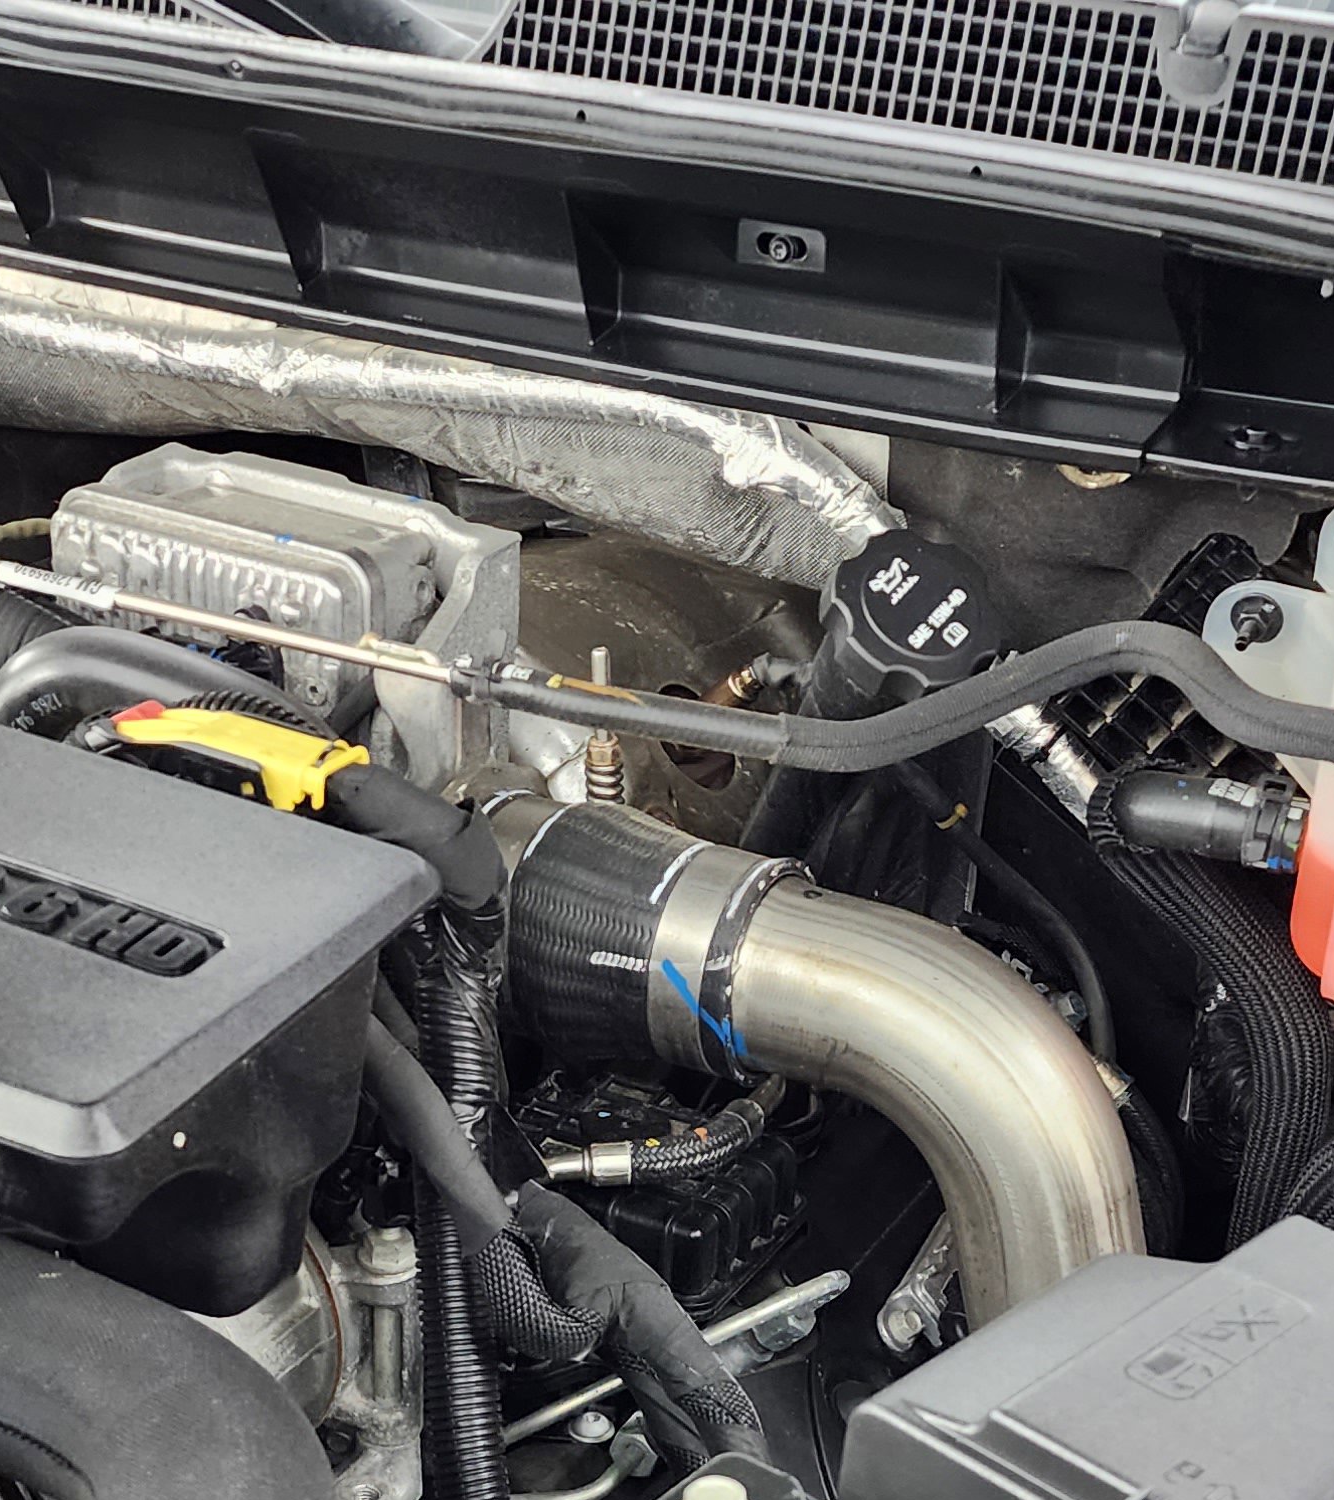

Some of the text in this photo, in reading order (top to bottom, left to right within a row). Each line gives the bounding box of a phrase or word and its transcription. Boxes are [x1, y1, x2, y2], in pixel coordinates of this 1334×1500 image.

[907, 623, 934, 649] SAE
[30, 692, 63, 717] 1266
[76, 905, 212, 977] HD
